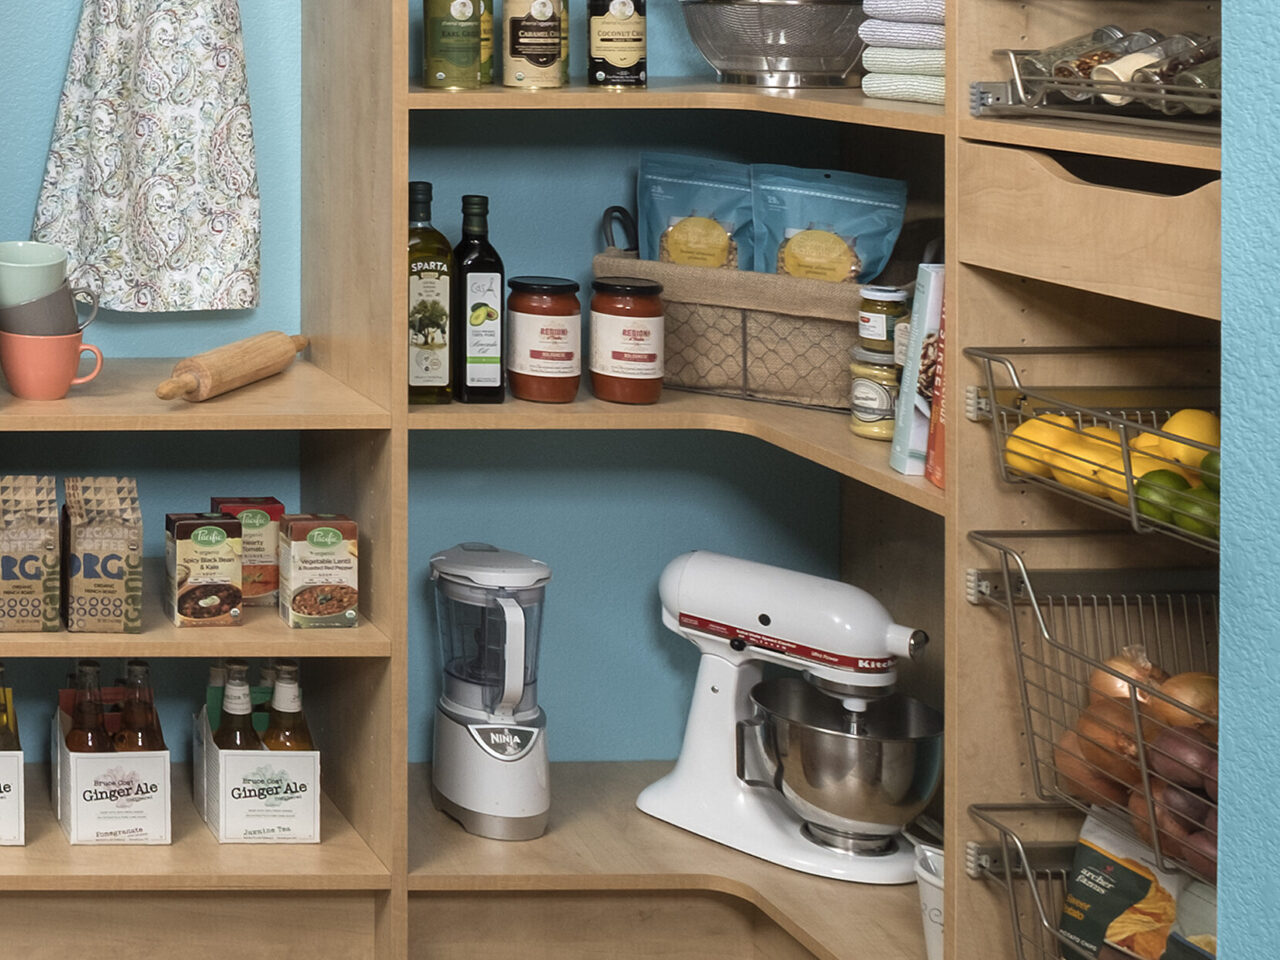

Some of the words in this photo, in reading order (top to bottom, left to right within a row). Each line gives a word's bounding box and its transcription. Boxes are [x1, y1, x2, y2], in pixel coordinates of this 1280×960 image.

[411, 261, 448, 272] SPARTA
[242, 512, 265, 526] Pacific
[197, 530, 223, 543] Pacific
[312, 531, 337, 544] Pacific
[70, 552, 124, 579] ORG
[490, 732, 521, 746] NINJA
[82, 787, 132, 801] Ginger
[134, 782, 158, 795] Ale
[231, 786, 282, 800] Ginger
[283, 782, 307, 794] Ale
[1075, 874, 1105, 895] farms
[1080, 868, 1115, 889] archer
